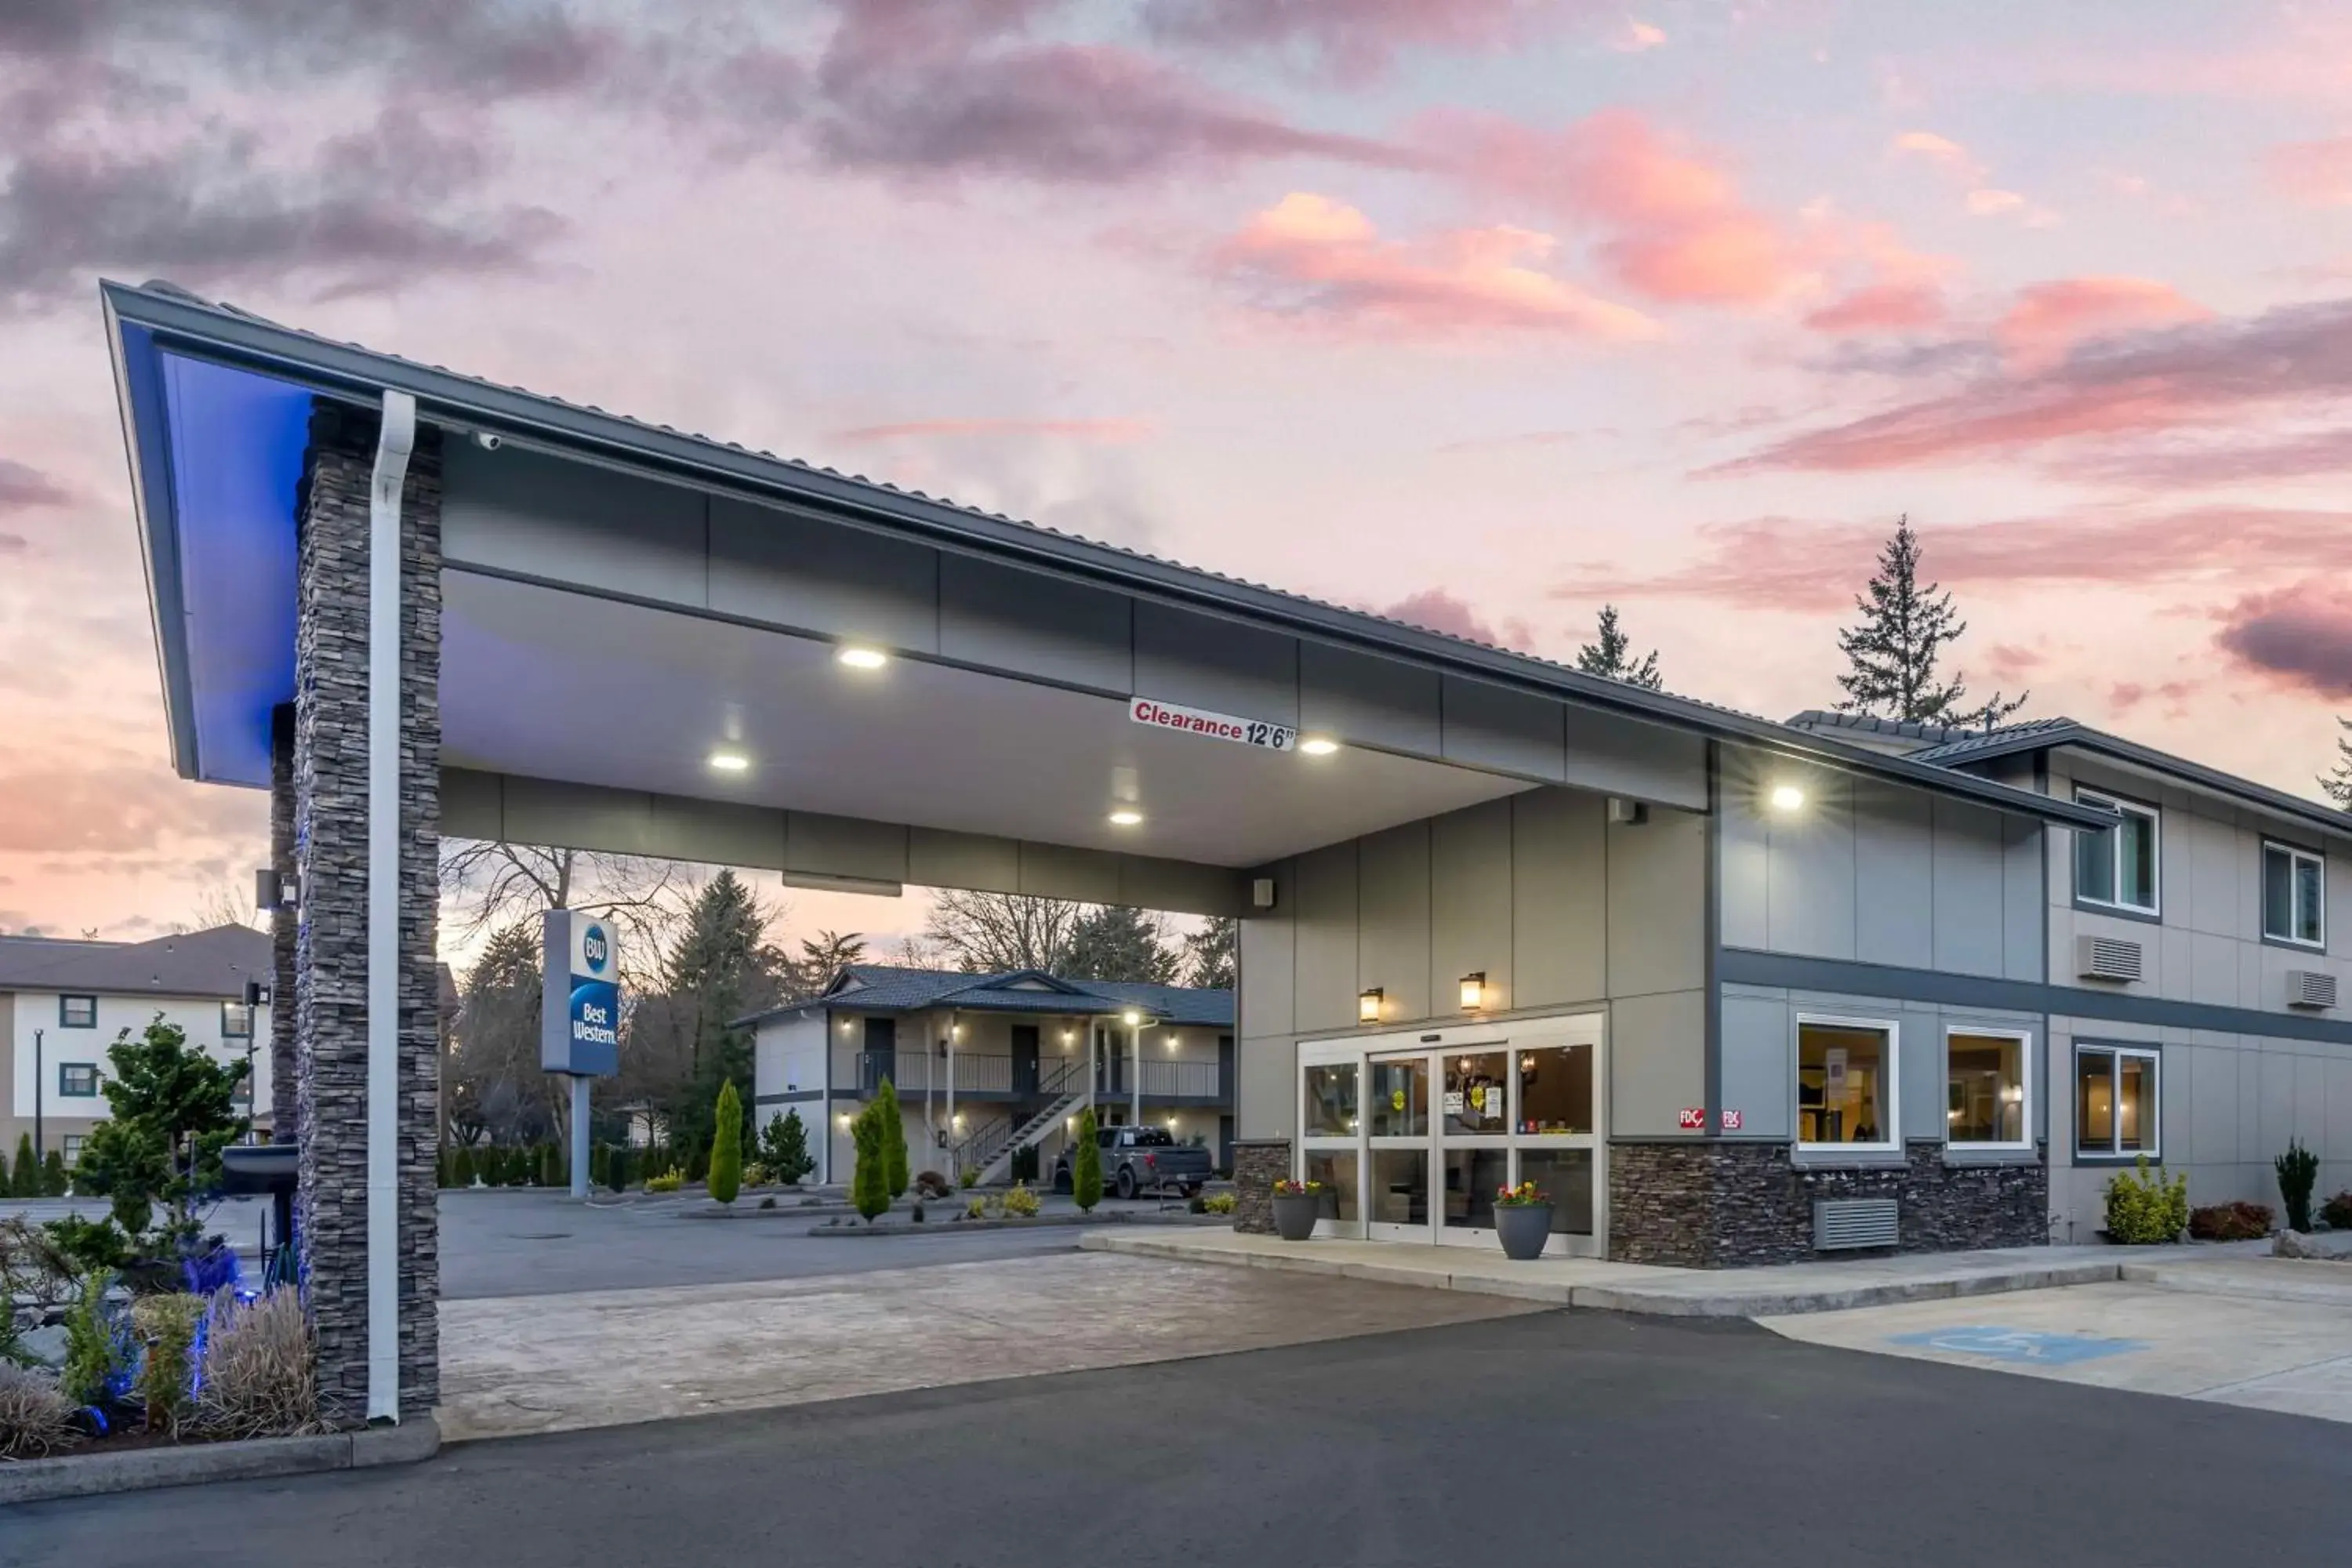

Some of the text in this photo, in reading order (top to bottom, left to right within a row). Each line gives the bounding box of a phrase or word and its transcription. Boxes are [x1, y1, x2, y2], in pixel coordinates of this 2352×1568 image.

[1135, 702, 1243, 739] Clearance
[586, 937, 604, 960] BW
[584, 1004, 607, 1024] Best
